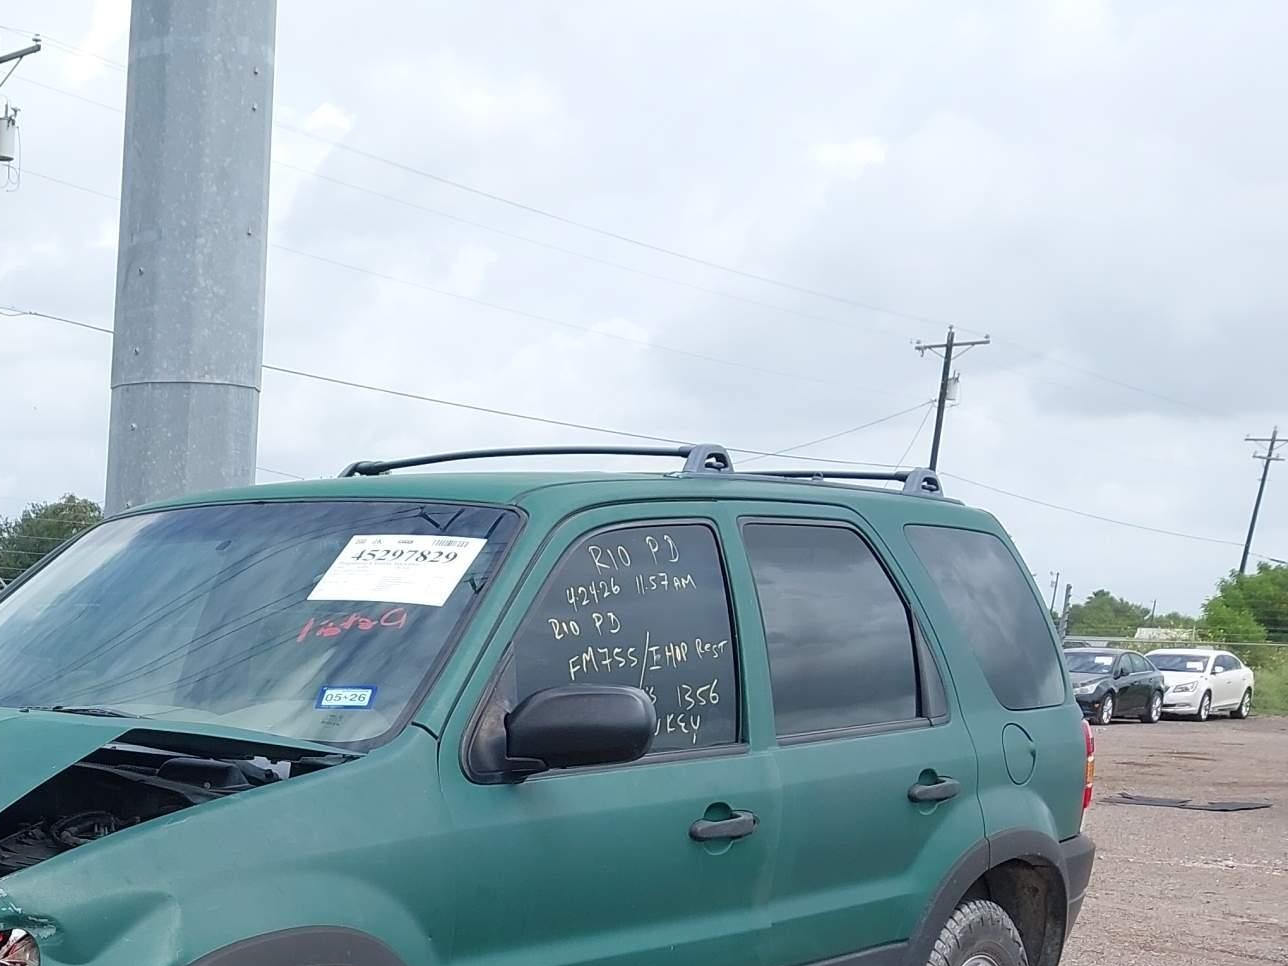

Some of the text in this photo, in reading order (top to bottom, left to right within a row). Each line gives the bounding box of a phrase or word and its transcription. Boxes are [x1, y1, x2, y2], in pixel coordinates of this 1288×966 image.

[352, 549, 458, 564] 45297829
[645, 534, 680, 564] PD
[591, 612, 622, 637] PD
[676, 679, 720, 711] 1356
